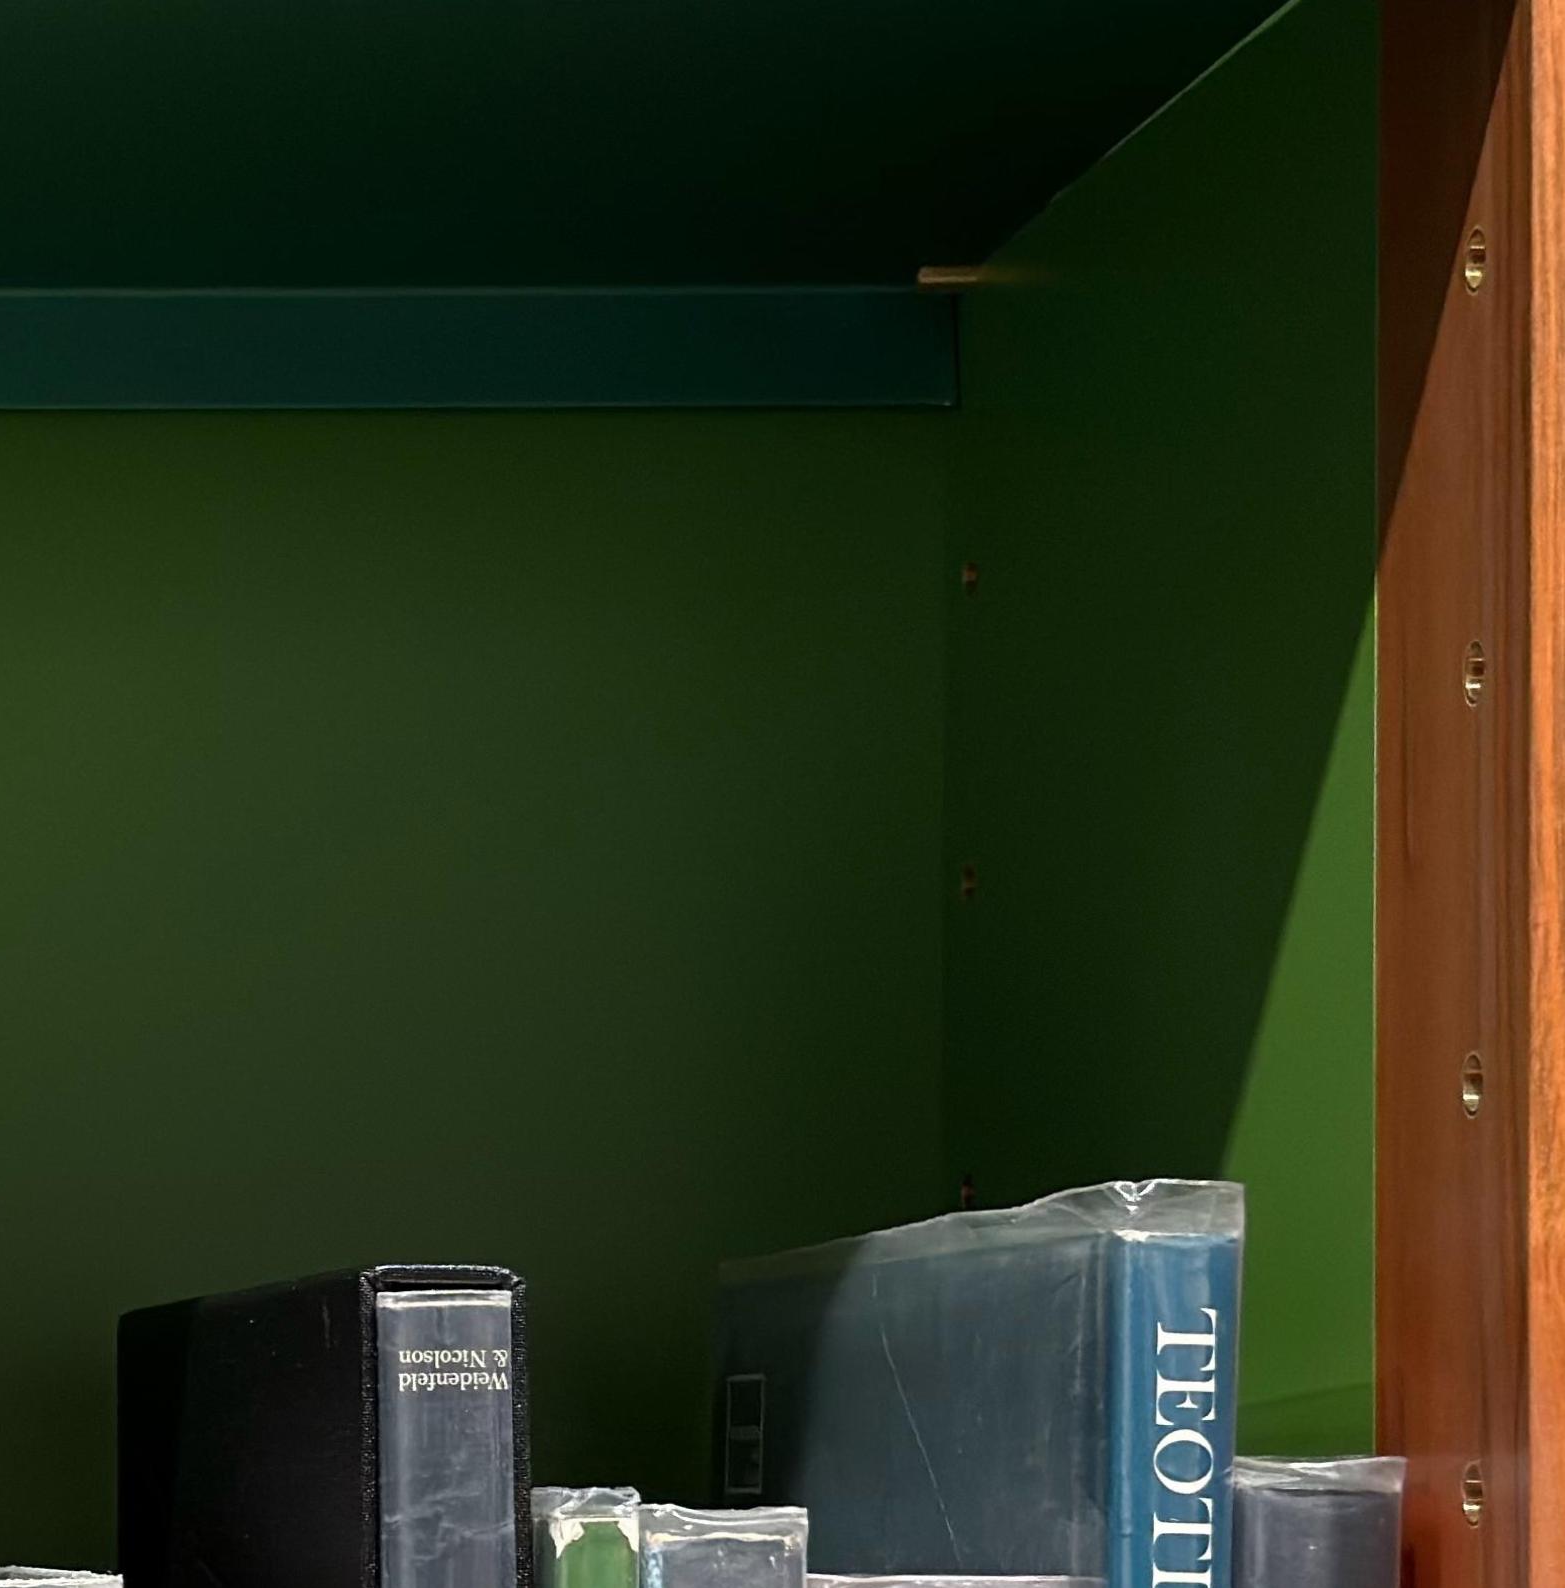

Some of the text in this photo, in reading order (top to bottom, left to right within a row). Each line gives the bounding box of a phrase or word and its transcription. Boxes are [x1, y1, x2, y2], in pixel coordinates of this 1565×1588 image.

[398, 1349, 509, 1369] & Nicolson
[398, 1371, 510, 1392] Weidenfeld
